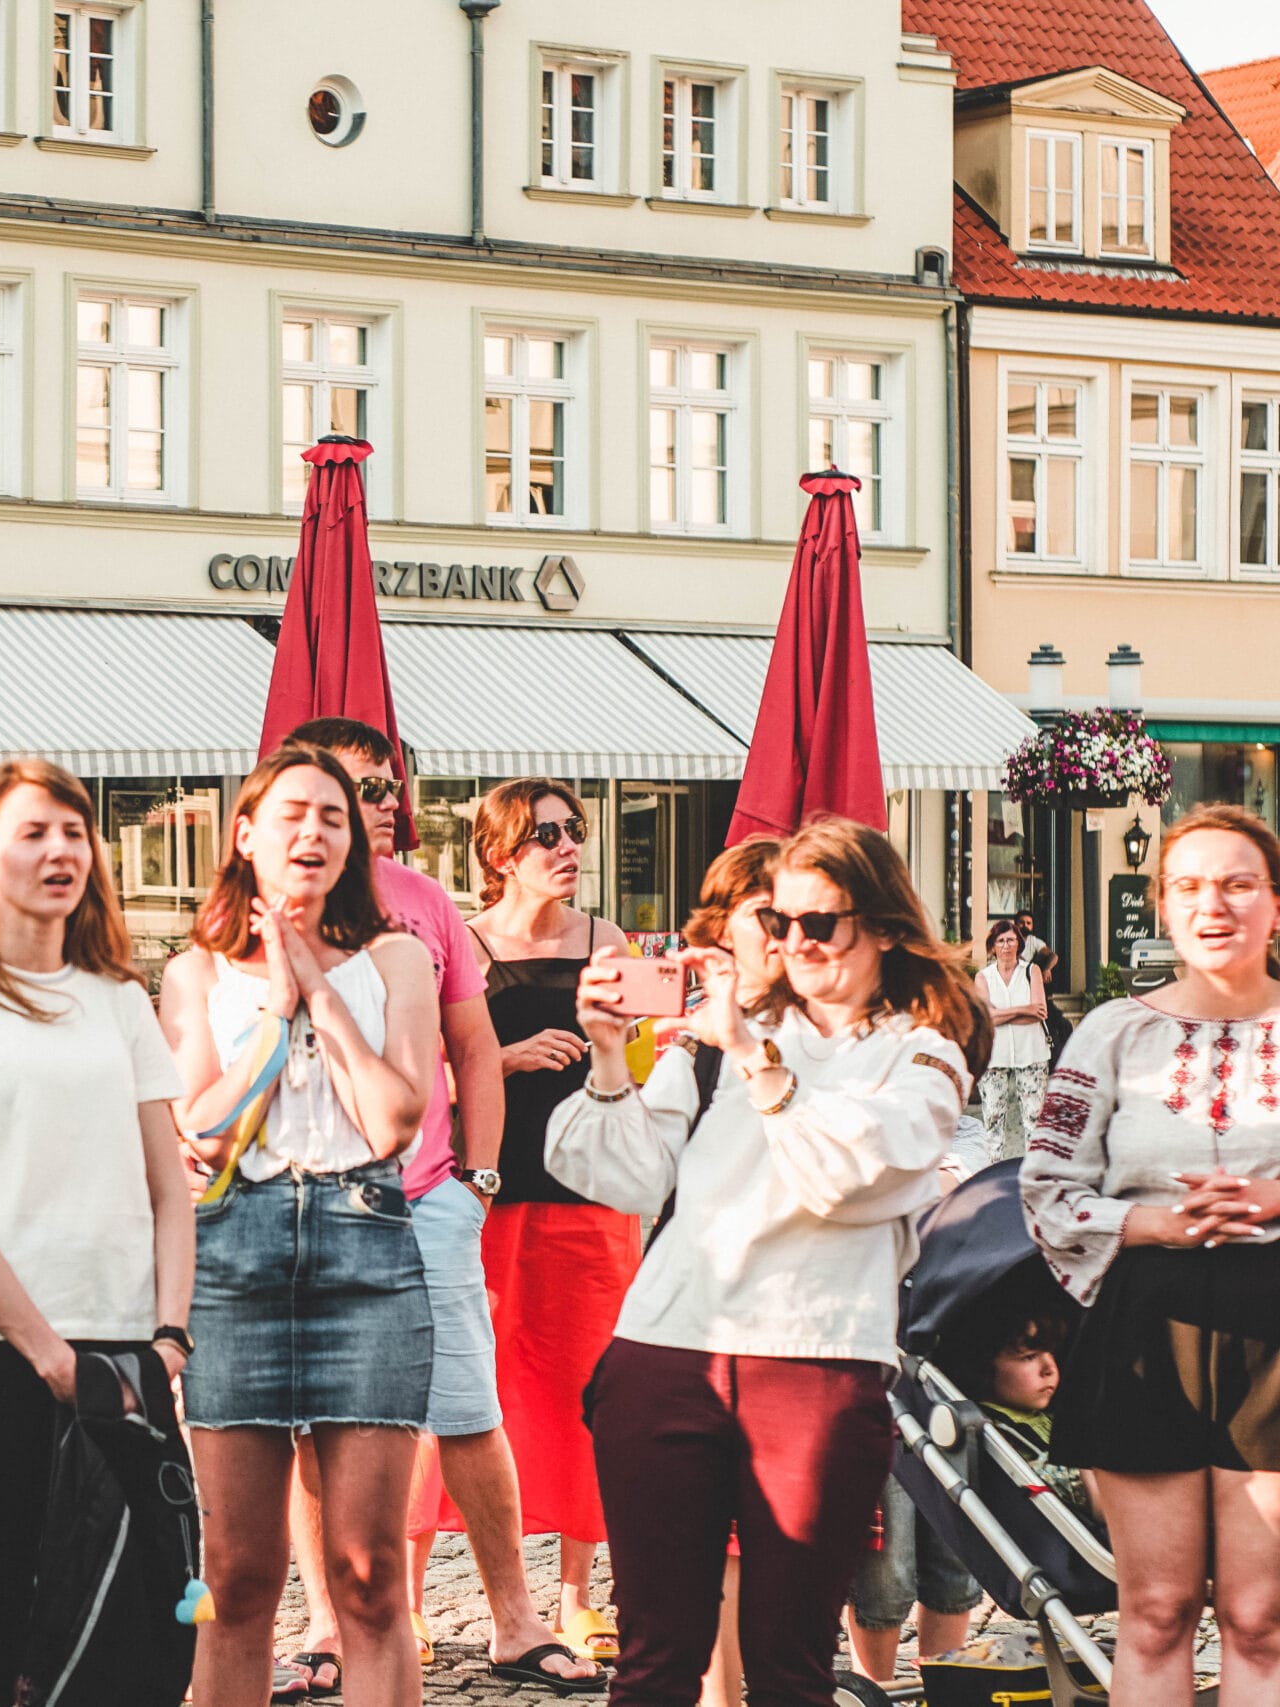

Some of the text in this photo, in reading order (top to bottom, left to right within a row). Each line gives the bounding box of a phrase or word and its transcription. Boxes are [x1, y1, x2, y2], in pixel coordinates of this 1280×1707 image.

[208, 553, 525, 601] COMRZBANK
[1126, 913, 1139, 921] am
[1115, 924, 1149, 939] Markt
